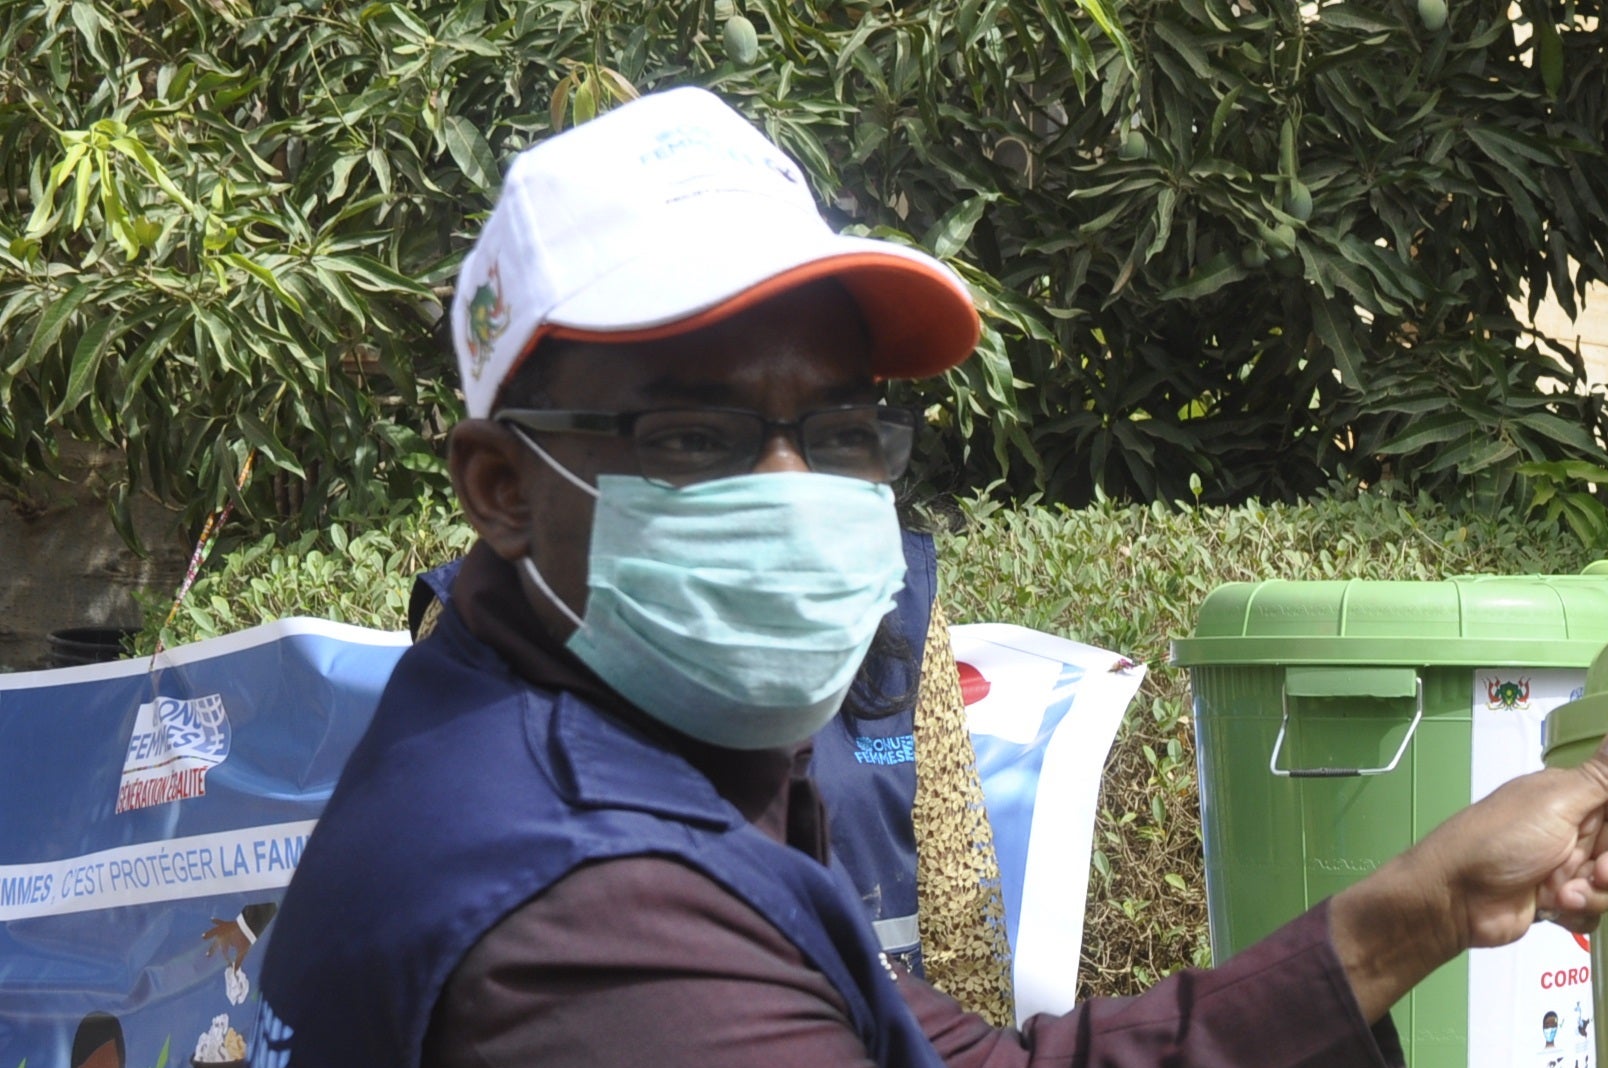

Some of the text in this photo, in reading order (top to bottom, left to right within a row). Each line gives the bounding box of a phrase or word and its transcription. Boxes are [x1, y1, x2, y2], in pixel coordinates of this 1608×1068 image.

[872, 737, 901, 752] ONU
[854, 750, 905, 765] FEMMES
[61, 862, 104, 898] C'EST
[110, 847, 216, 891] PROTÉGER
[220, 843, 249, 878] LA
[253, 835, 310, 873] FAM
[1540, 966, 1593, 990] CORO
